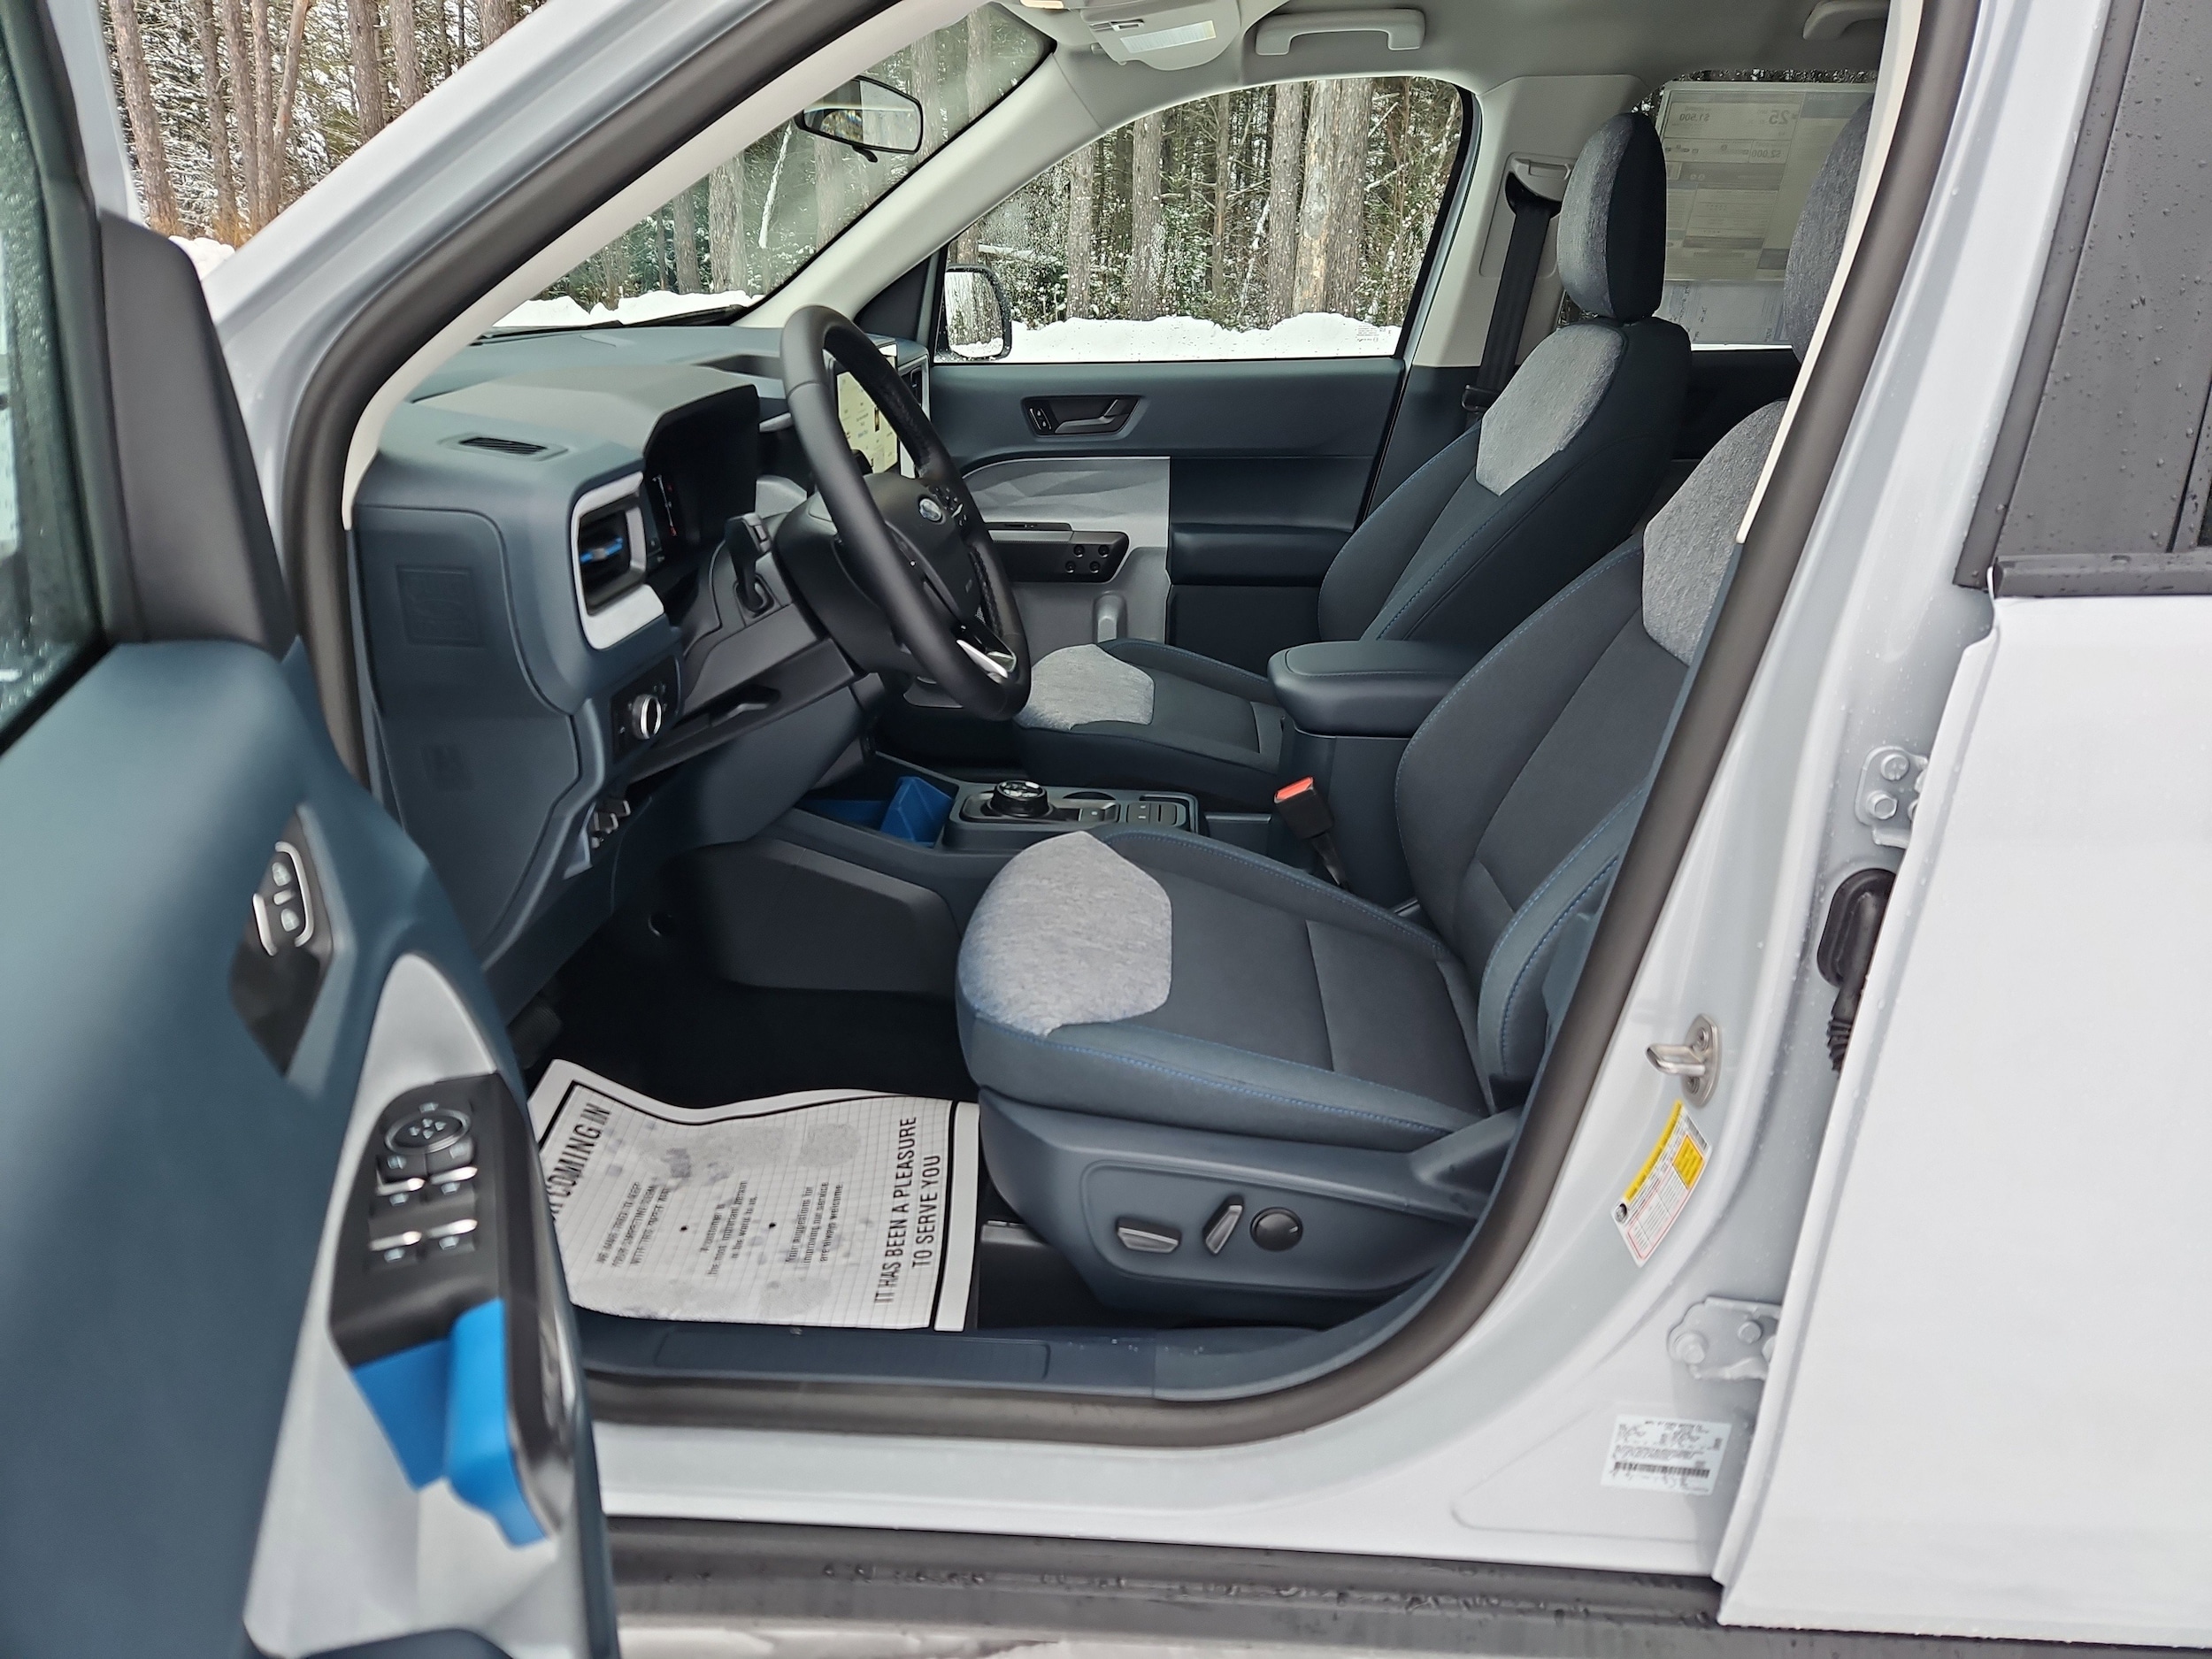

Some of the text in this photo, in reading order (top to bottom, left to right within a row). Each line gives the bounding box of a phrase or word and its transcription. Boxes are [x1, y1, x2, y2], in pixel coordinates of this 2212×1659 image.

[547, 1102, 611, 1197] COMING IN
[873, 1117, 917, 1303] IT HAS BEEN A PLEASURE
[911, 1156, 941, 1269] TO SERVE YOU
